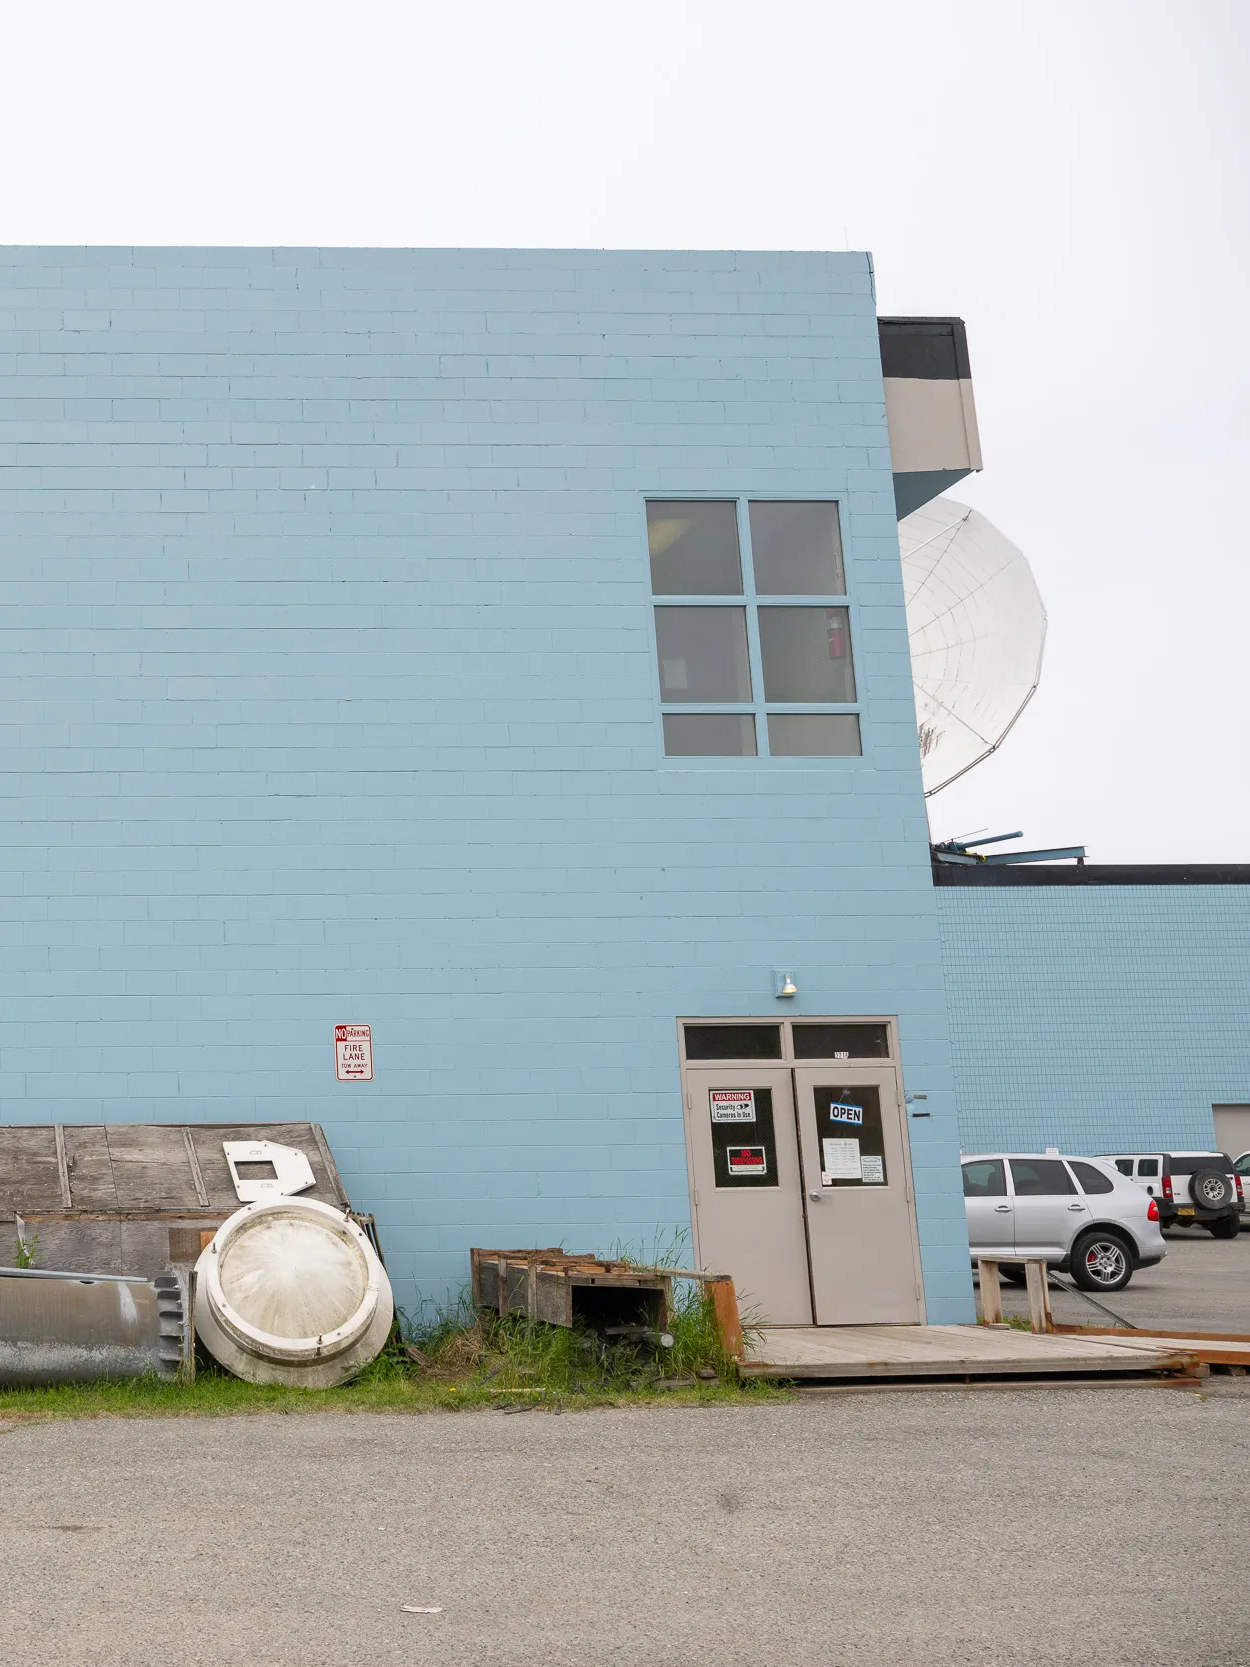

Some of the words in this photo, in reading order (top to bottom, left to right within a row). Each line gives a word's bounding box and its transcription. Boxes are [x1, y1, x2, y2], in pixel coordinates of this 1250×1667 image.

[336, 1028, 347, 1039] NO
[344, 1044, 364, 1052] FIRE
[714, 1093, 750, 1101] WARNING
[715, 1103, 736, 1111] Security
[832, 1106, 861, 1121] OPEN
[741, 1149, 751, 1157] NO
